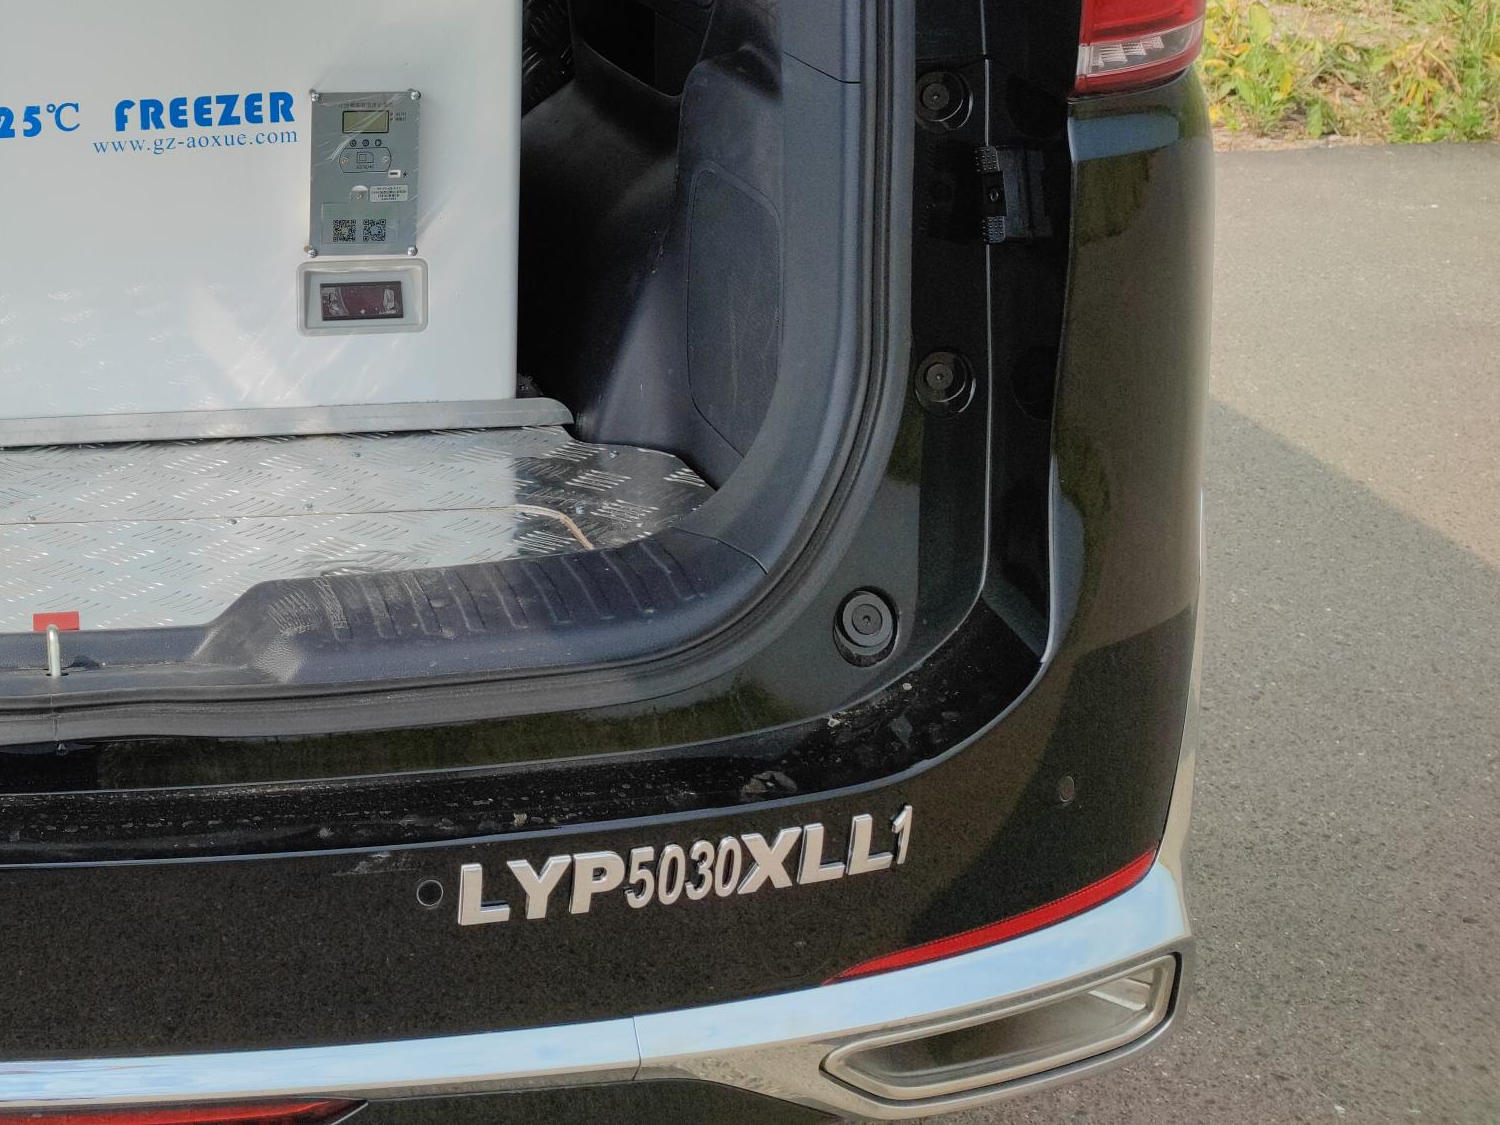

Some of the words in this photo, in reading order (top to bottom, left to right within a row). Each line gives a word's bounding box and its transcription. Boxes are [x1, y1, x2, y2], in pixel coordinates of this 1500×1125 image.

[114, 91, 295, 132] FREEZER
[92, 129, 298, 155] www.gz-aoxue.com
[458, 804, 913, 926] LYP5030XLL1
